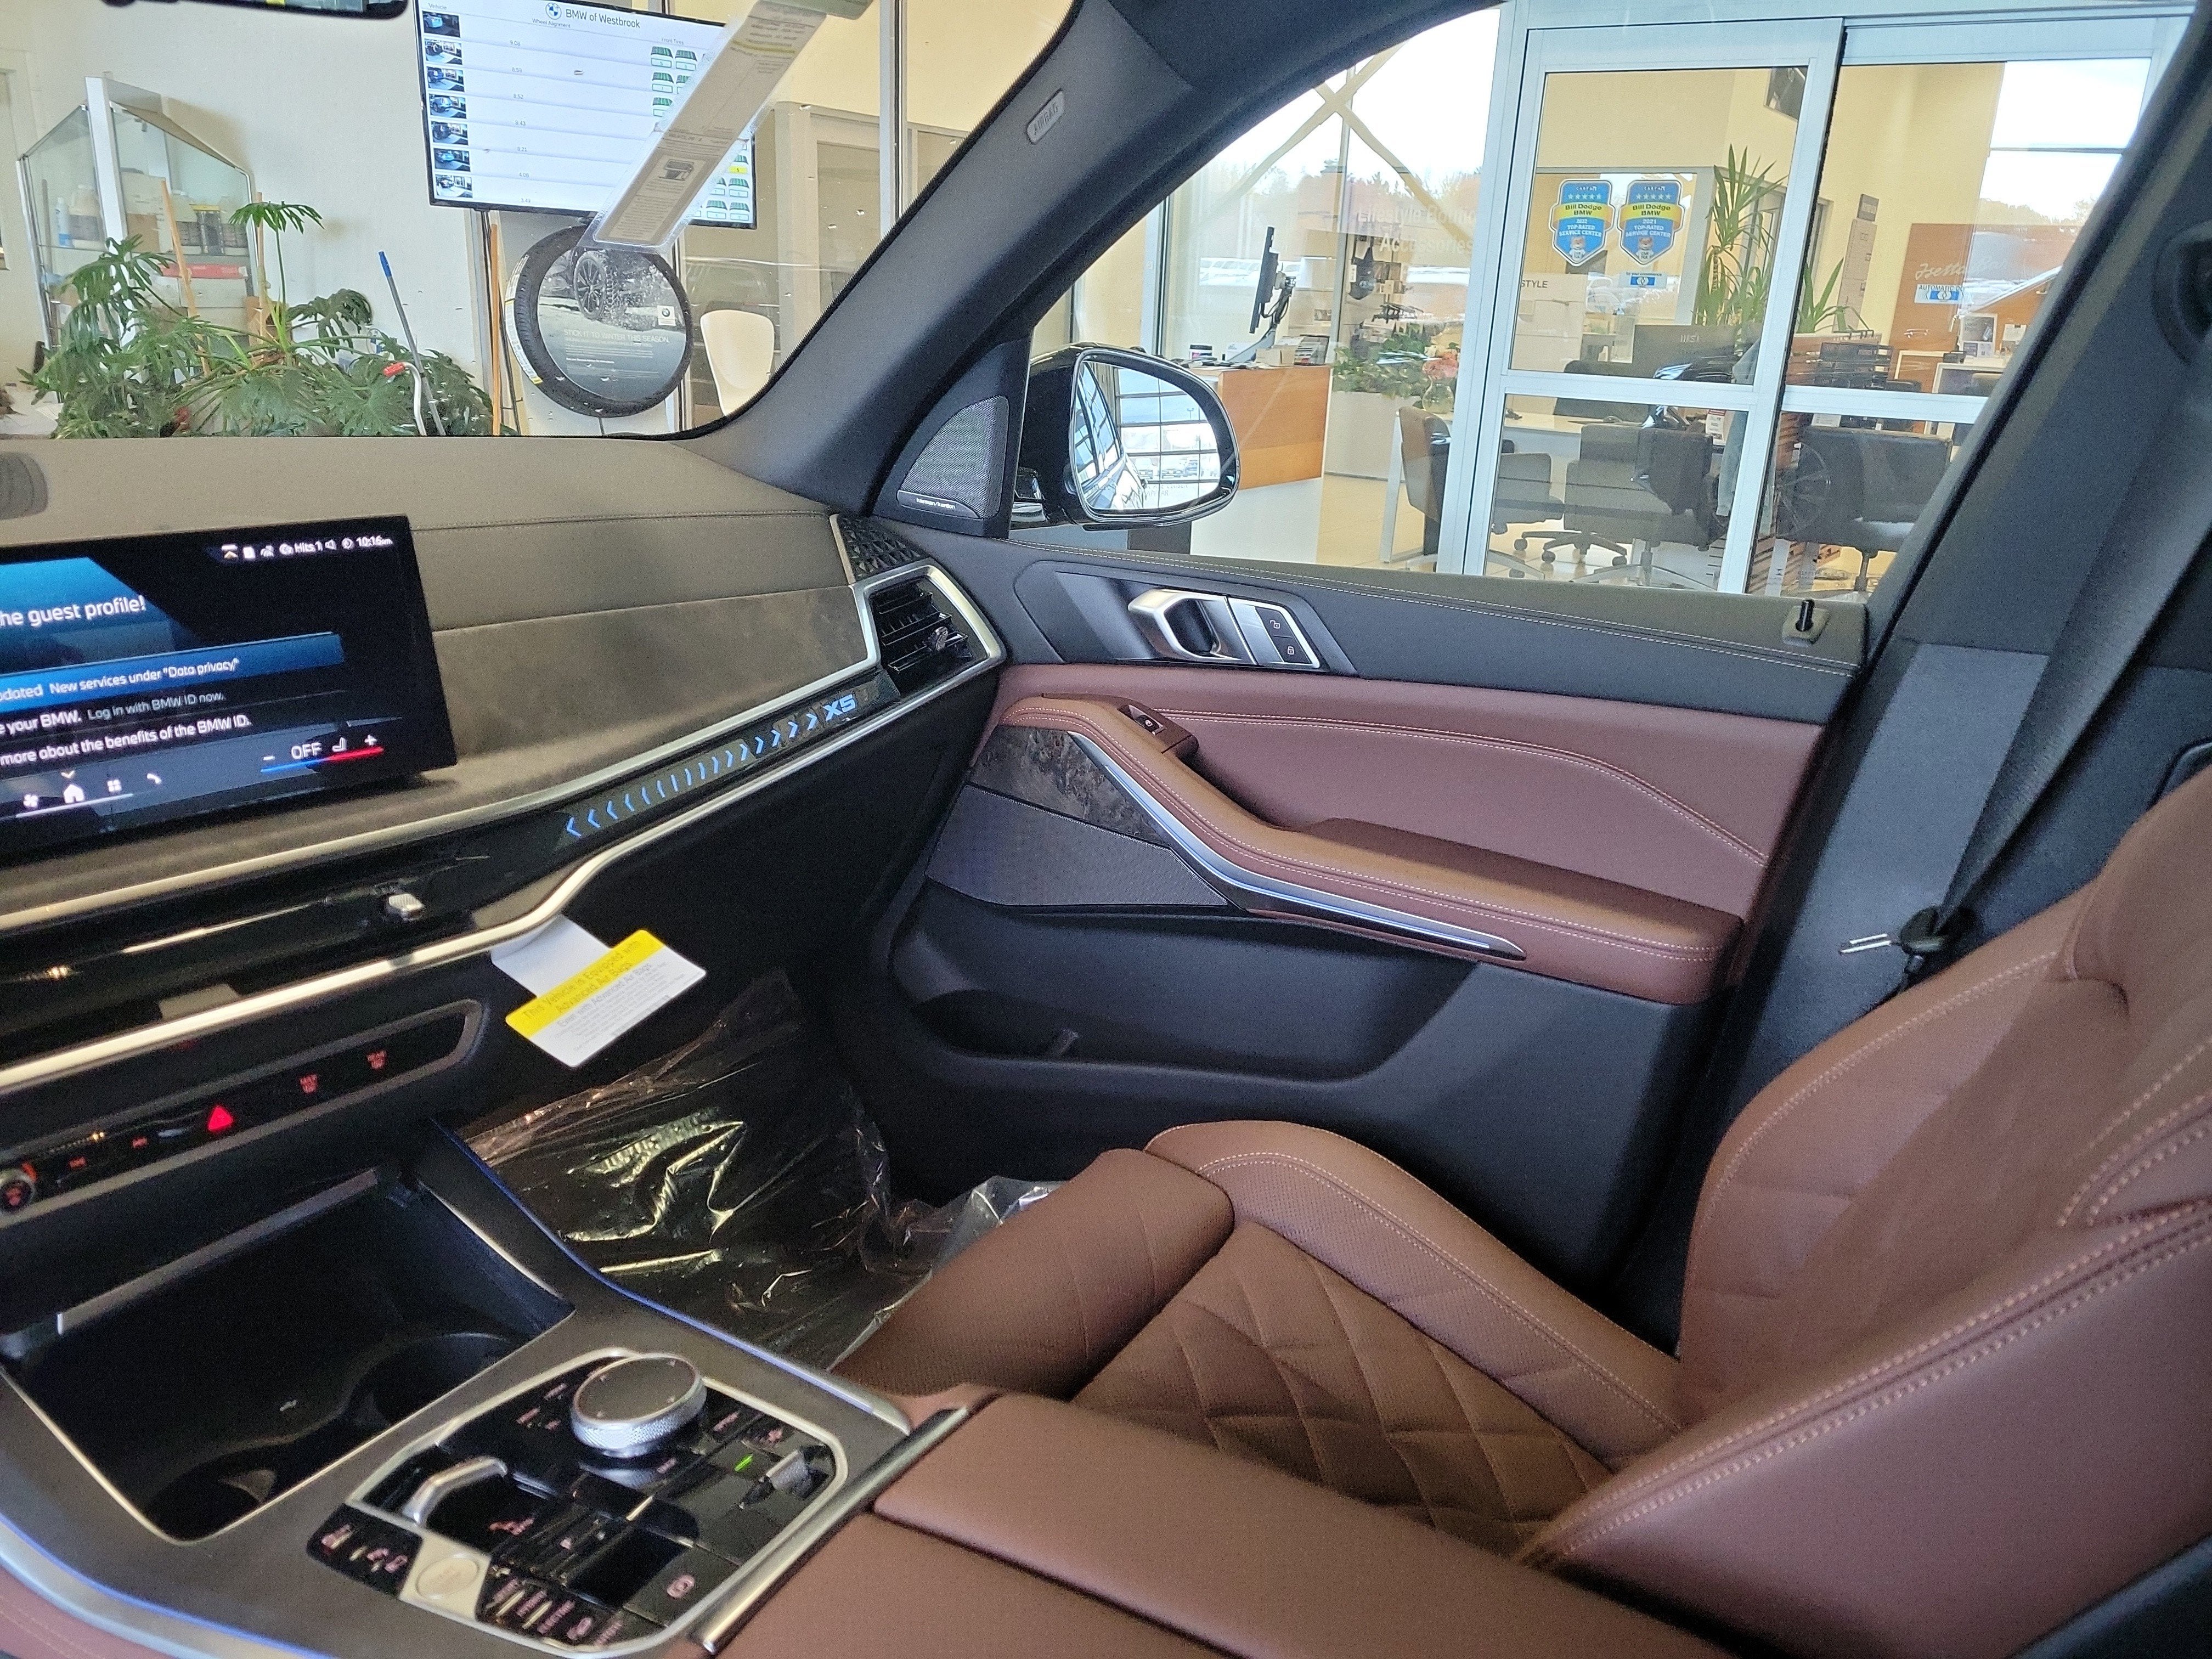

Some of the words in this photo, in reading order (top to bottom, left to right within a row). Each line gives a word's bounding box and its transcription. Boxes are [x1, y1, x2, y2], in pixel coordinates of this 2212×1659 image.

[548, 20, 571, 29] Alignment
[566, 9, 587, 21] BMW
[589, 13, 597, 21] of
[599, 13, 641, 29] Westbrook
[0, 610, 24, 627] he
[28, 604, 81, 627] guest
[84, 595, 146, 620] profile!
[50, 682, 78, 695] New
[80, 675, 127, 691] services
[129, 670, 161, 685] under
[7, 718, 38, 735] your
[40, 710, 82, 727] BMW.
[88, 708, 110, 721] Log
[112, 706, 125, 716] in
[126, 701, 150, 715] with
[152, 696, 182, 711] BMW
[184, 691, 197, 706] ID
[823, 694, 856, 721] X5
[0, 750, 37, 765] more
[38, 743, 80, 760] about
[81, 739, 103, 754] the
[105, 729, 158, 749] benefits
[160, 726, 174, 741] of
[174, 723, 196, 737] the
[198, 716, 232, 734] BMW
[291, 742, 322, 760] OFF
[522, 1001, 544, 1020] This
[544, 981, 575, 1006] Vehicle
